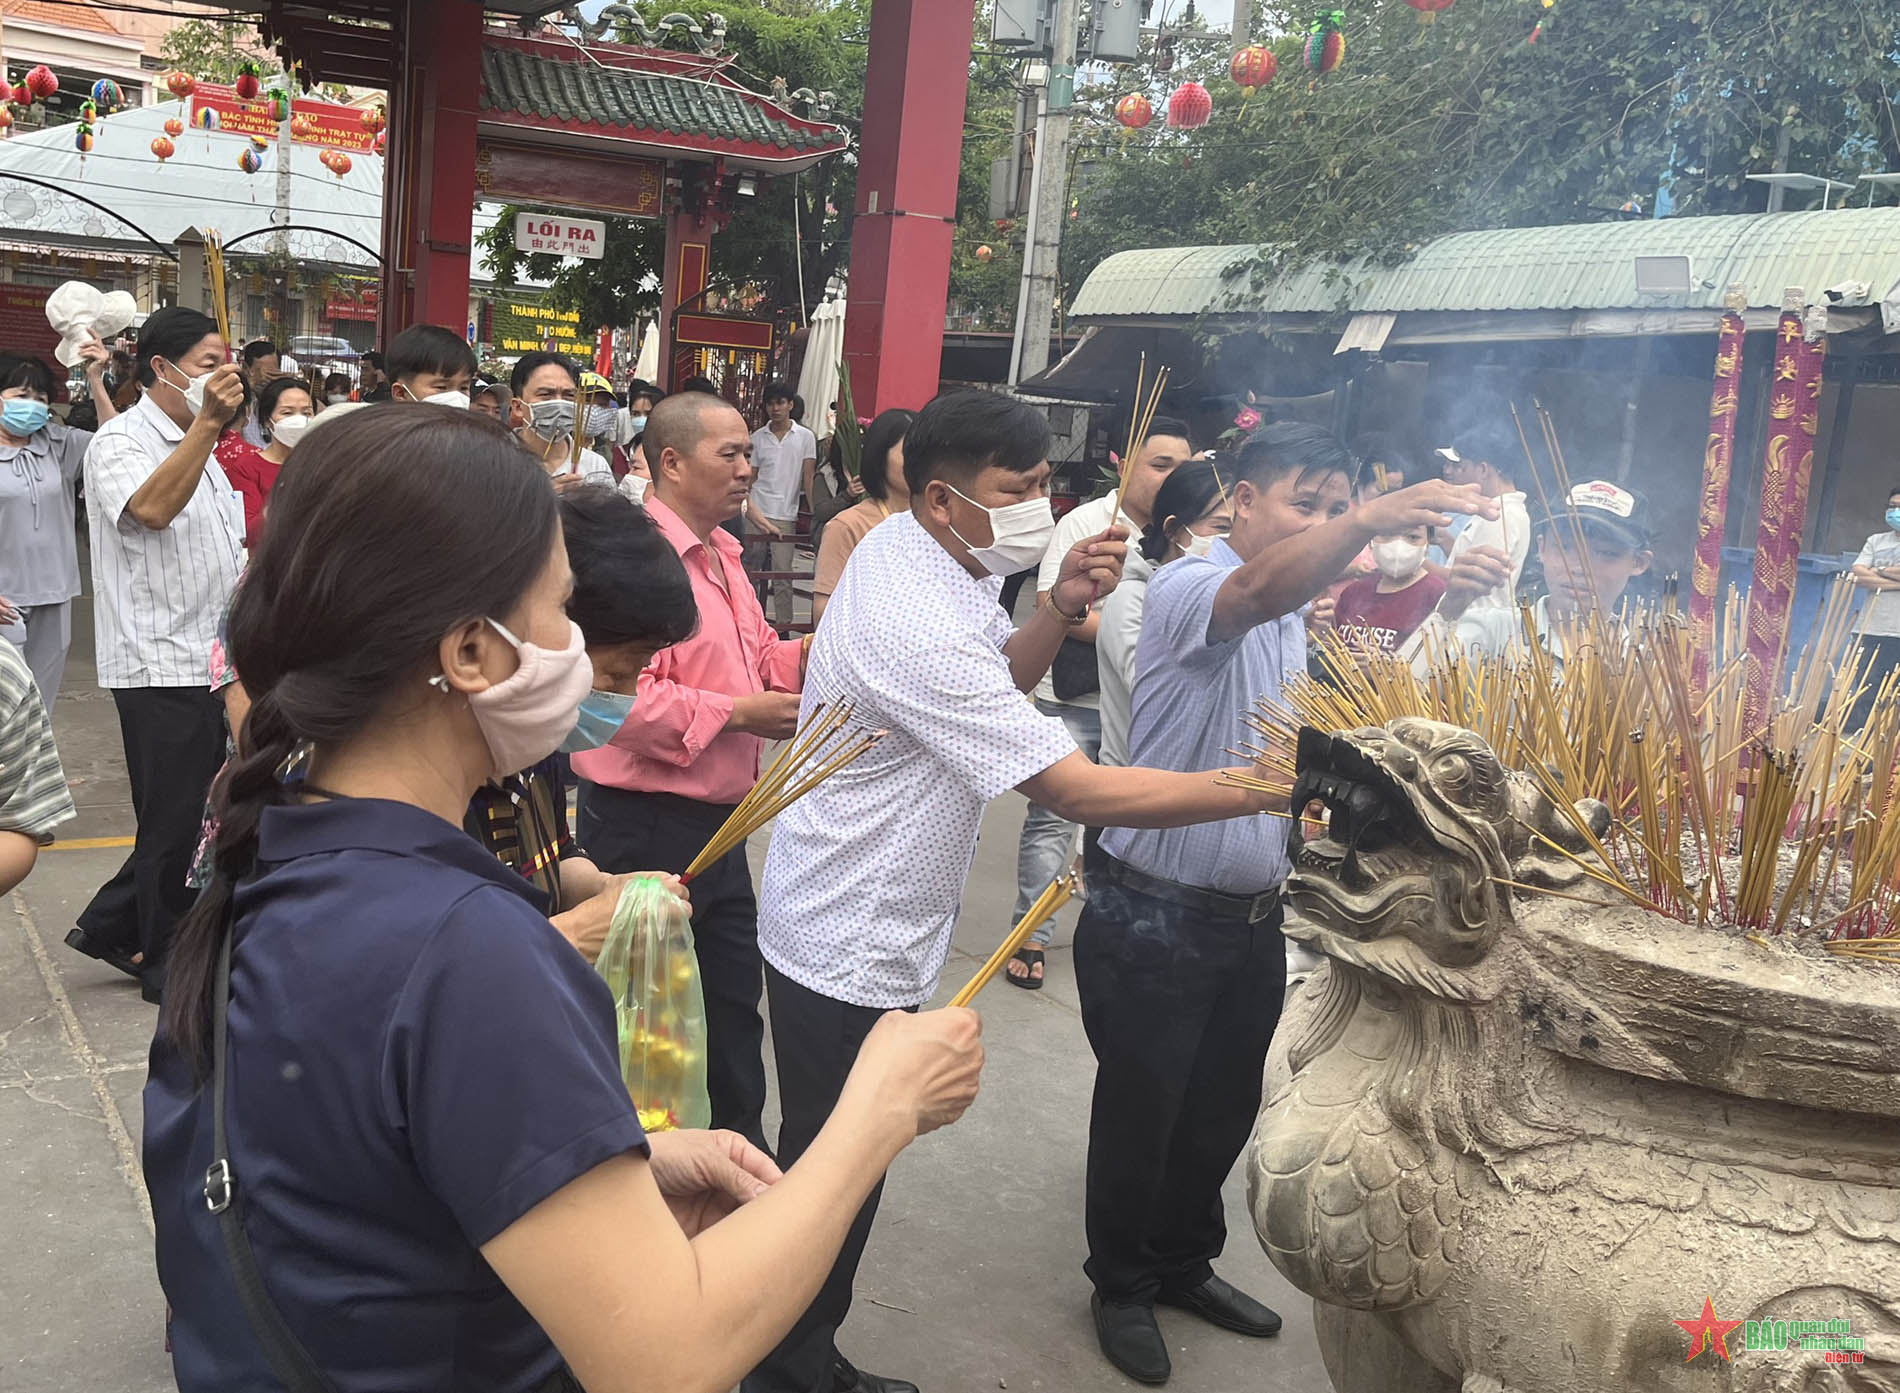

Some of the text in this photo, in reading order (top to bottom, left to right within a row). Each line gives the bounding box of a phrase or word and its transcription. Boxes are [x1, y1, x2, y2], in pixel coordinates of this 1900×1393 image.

[342, 140, 362, 149] 2023
[527, 220, 596, 242] LỐI RA
[511, 304, 538, 318] THÀNH
[536, 324, 555, 336] THO
